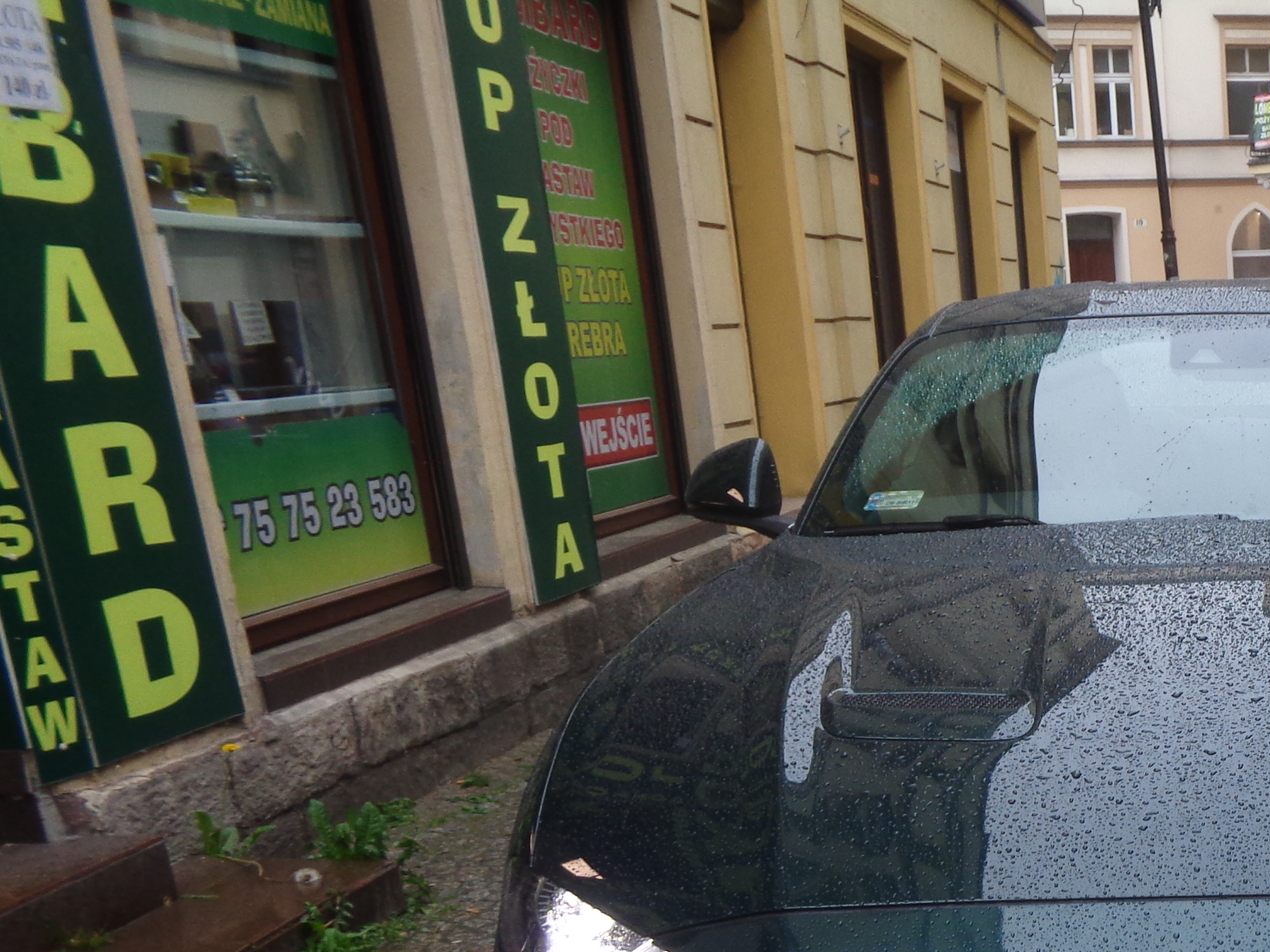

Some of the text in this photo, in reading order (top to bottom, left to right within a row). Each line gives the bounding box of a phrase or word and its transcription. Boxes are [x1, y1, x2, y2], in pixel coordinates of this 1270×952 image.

[525, 46, 589, 104] ŻYCZKI
[537, 107, 574, 148] POD
[574, 265, 632, 305] ZŁOTA
[0, 0, 200, 718] BARD
[566, 319, 628, 359] REBRA
[496, 195, 585, 580] ZŁOTA
[579, 407, 653, 457] WEJŚCIE
[231, 471, 416, 552] 75 75 23 583
[0, 405, 78, 752] STAW
